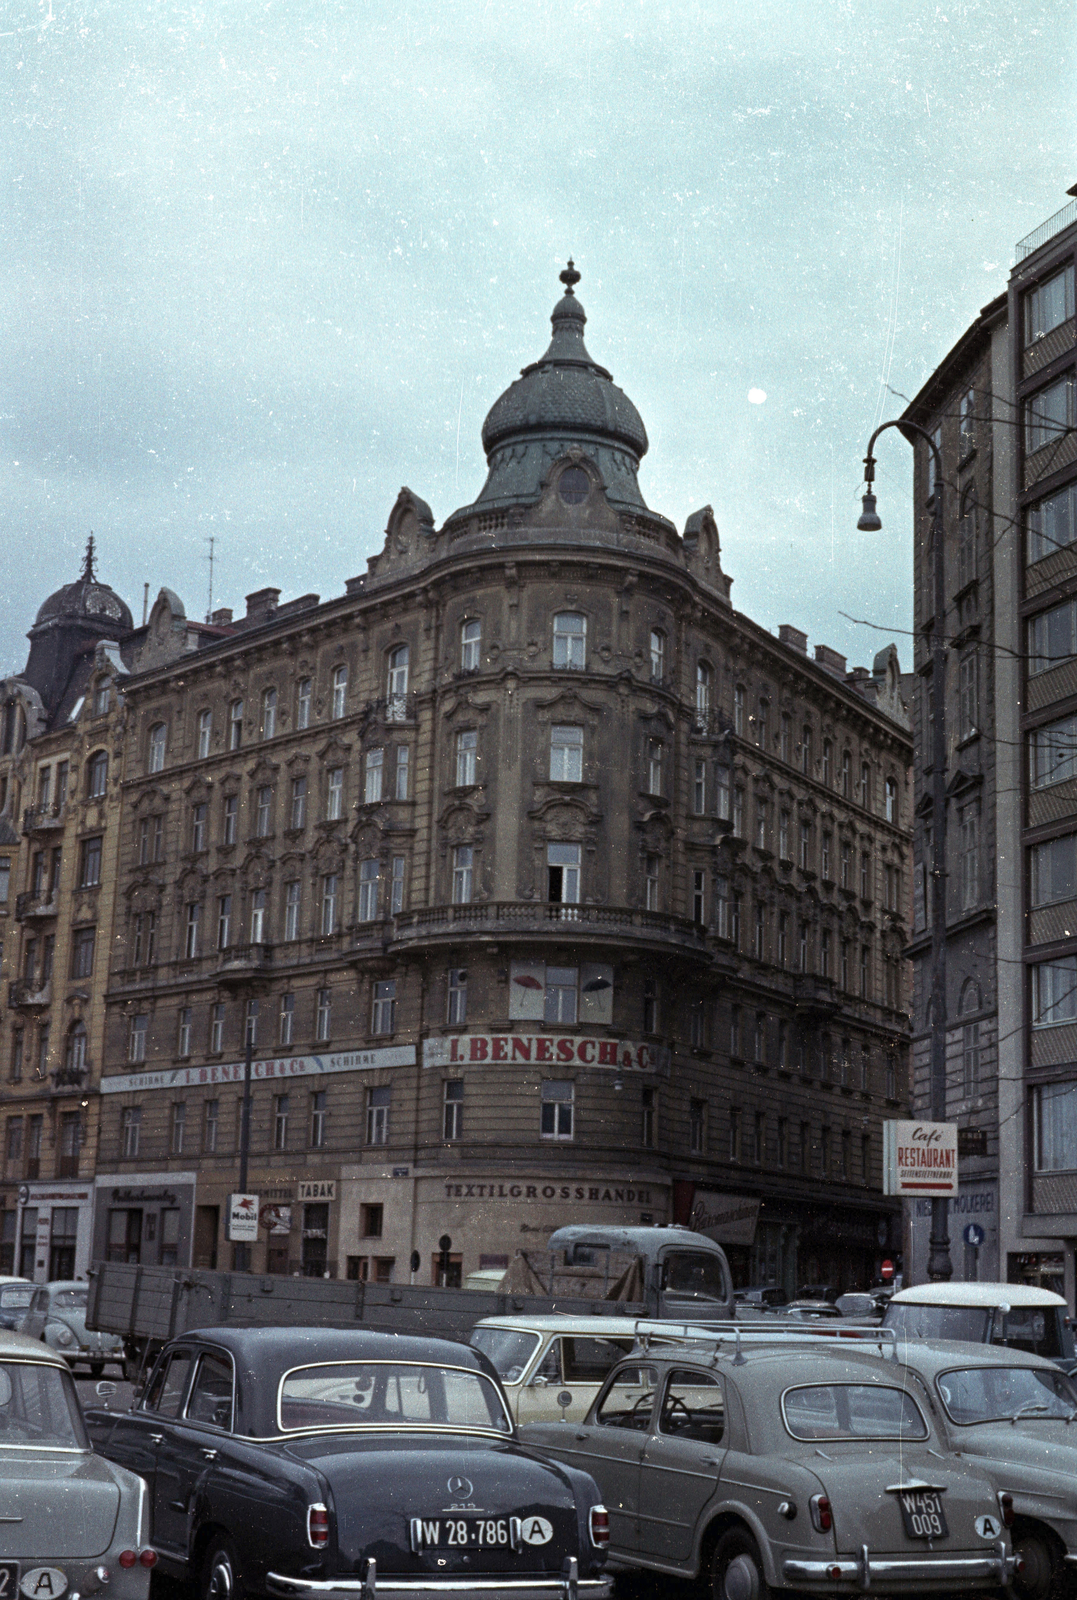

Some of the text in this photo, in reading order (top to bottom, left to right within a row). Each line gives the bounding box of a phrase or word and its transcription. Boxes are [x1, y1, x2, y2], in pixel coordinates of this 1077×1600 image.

[330, 1053, 376, 1068] SCHIRME
[469, 1037, 619, 1066] BENESCH
[199, 1059, 274, 1083] BENECH
[912, 1127, 943, 1147] Café
[898, 1147, 956, 1169] RESTAURANT
[301, 1183, 334, 1198] TABAK
[445, 1184, 652, 1204] TEXTILGROSSHANDEL
[953, 1192, 994, 1214] MOLKEREI
[232, 1212, 257, 1221] Mobil
[902, 1492, 942, 1514] W451
[423, 1520, 440, 1545] W
[529, 1519, 547, 1540] A
[911, 1514, 942, 1536] 009
[982, 1518, 996, 1537] A
[34, 1572, 54, 1595] A
